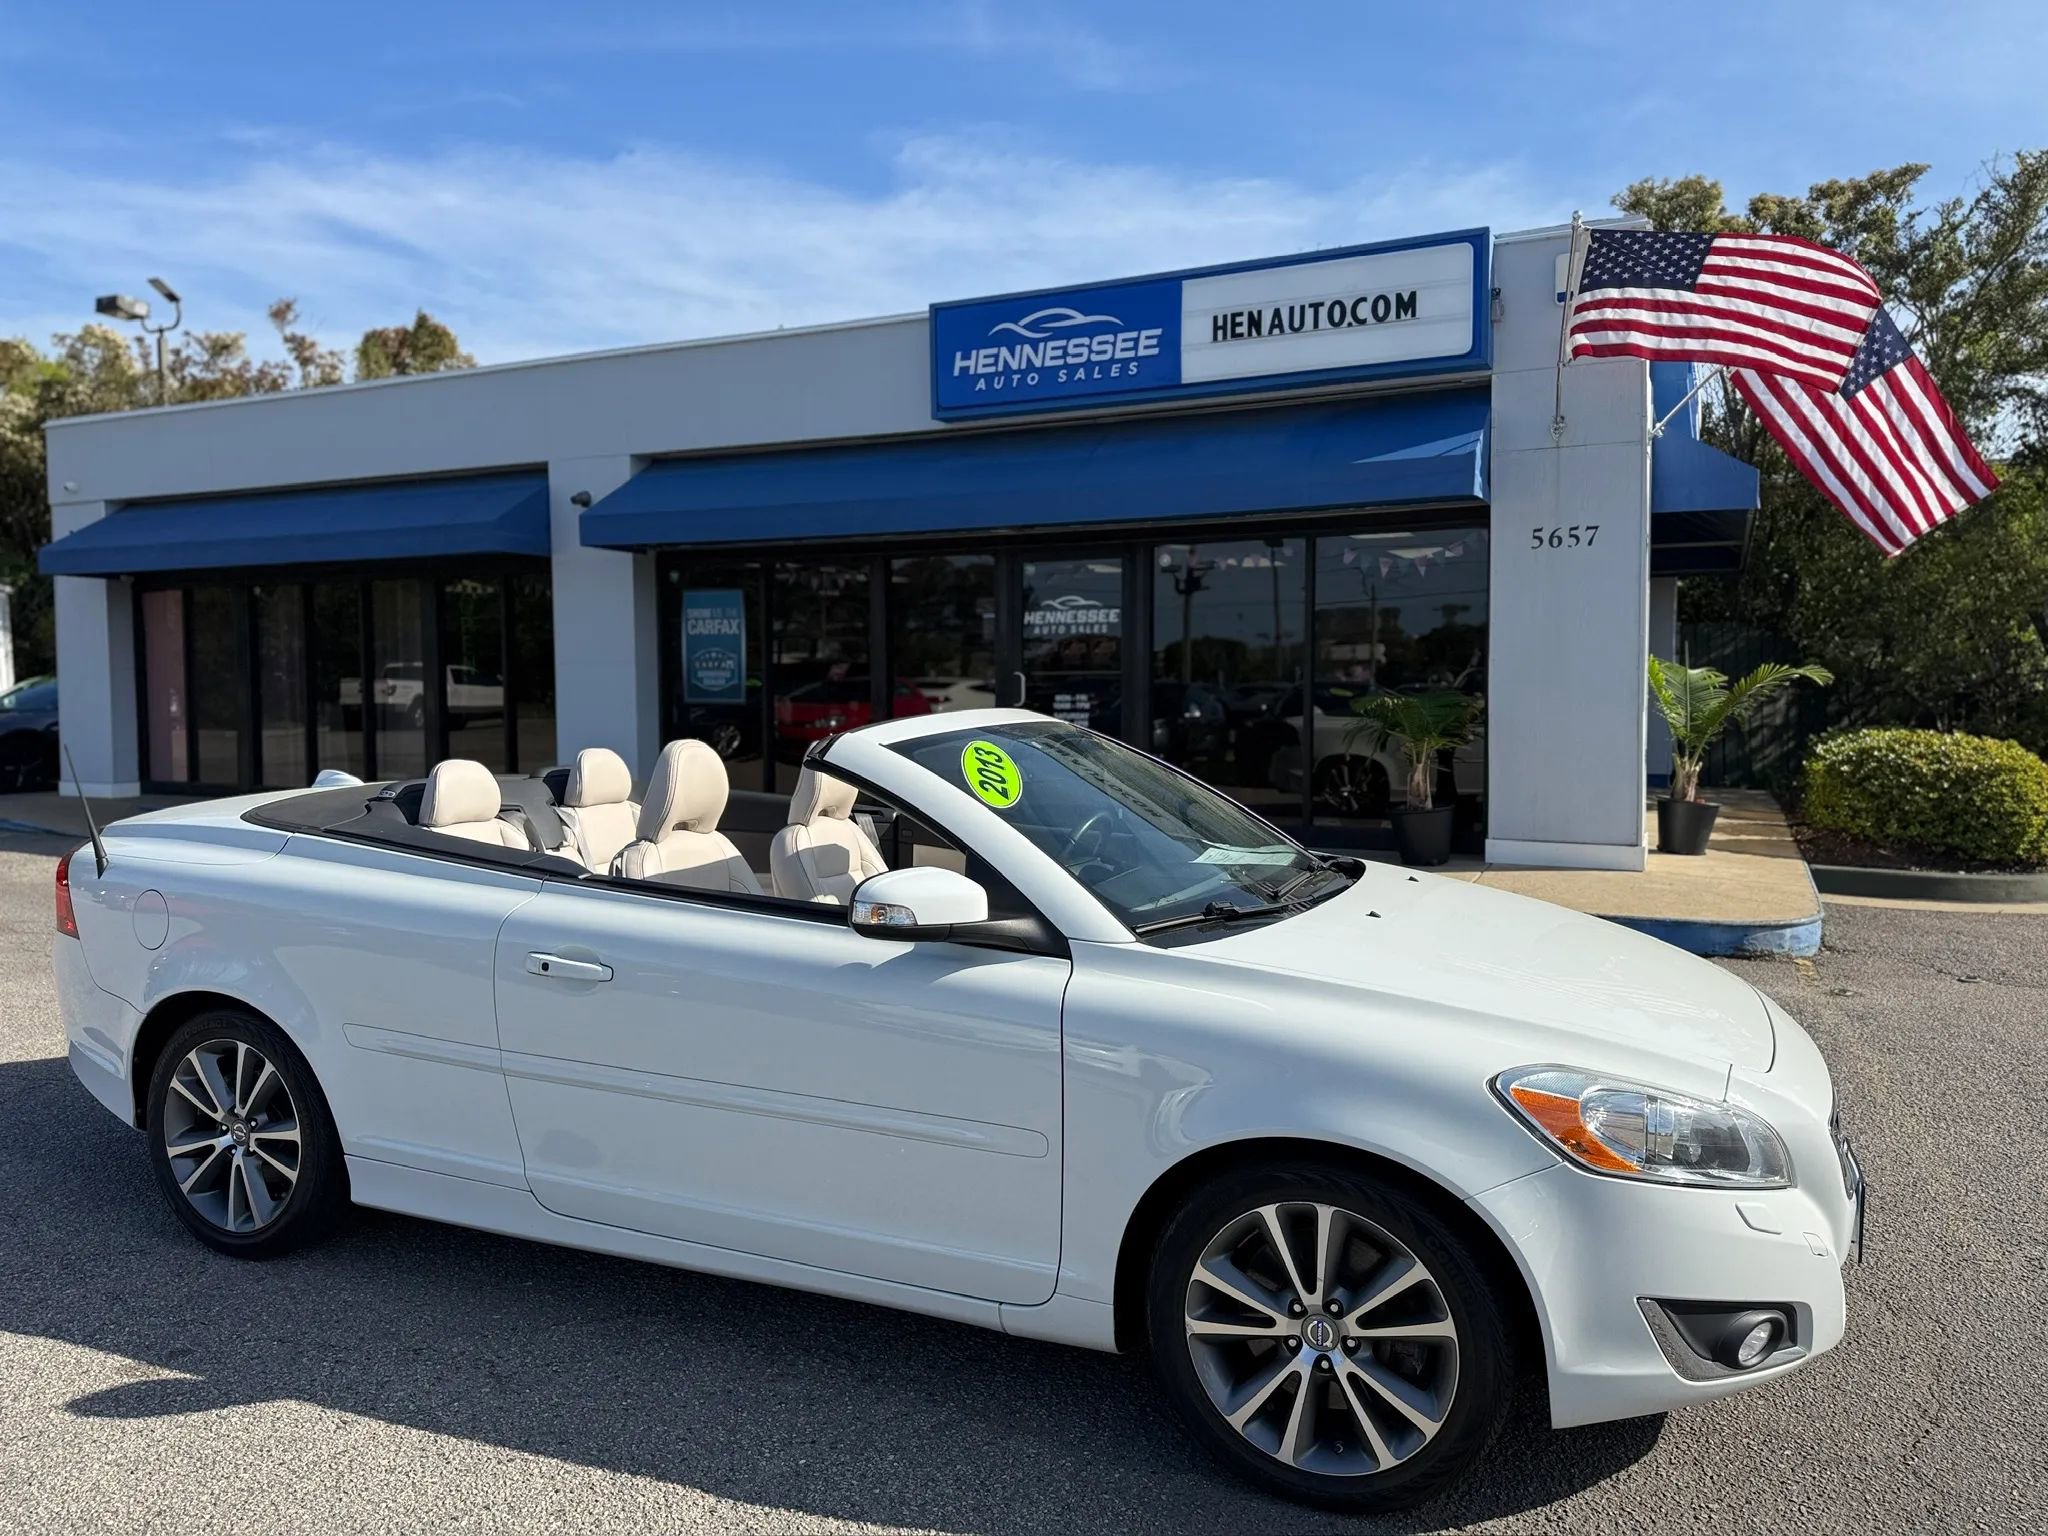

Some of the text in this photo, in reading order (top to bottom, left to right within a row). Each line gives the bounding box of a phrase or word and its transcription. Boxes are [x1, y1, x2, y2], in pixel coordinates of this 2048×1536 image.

[1212, 291, 1417, 341] HENAUTO.COM
[953, 328, 1163, 377] HENNESSEE
[975, 362, 1139, 391] AUTO SALES
[1530, 525, 1600, 550] 5657
[687, 619, 740, 635] CARFAX
[1024, 609, 1120, 624] HENNESSEE
[1034, 624, 1108, 634] AUTO SALES
[974, 746, 1009, 800] 2013
